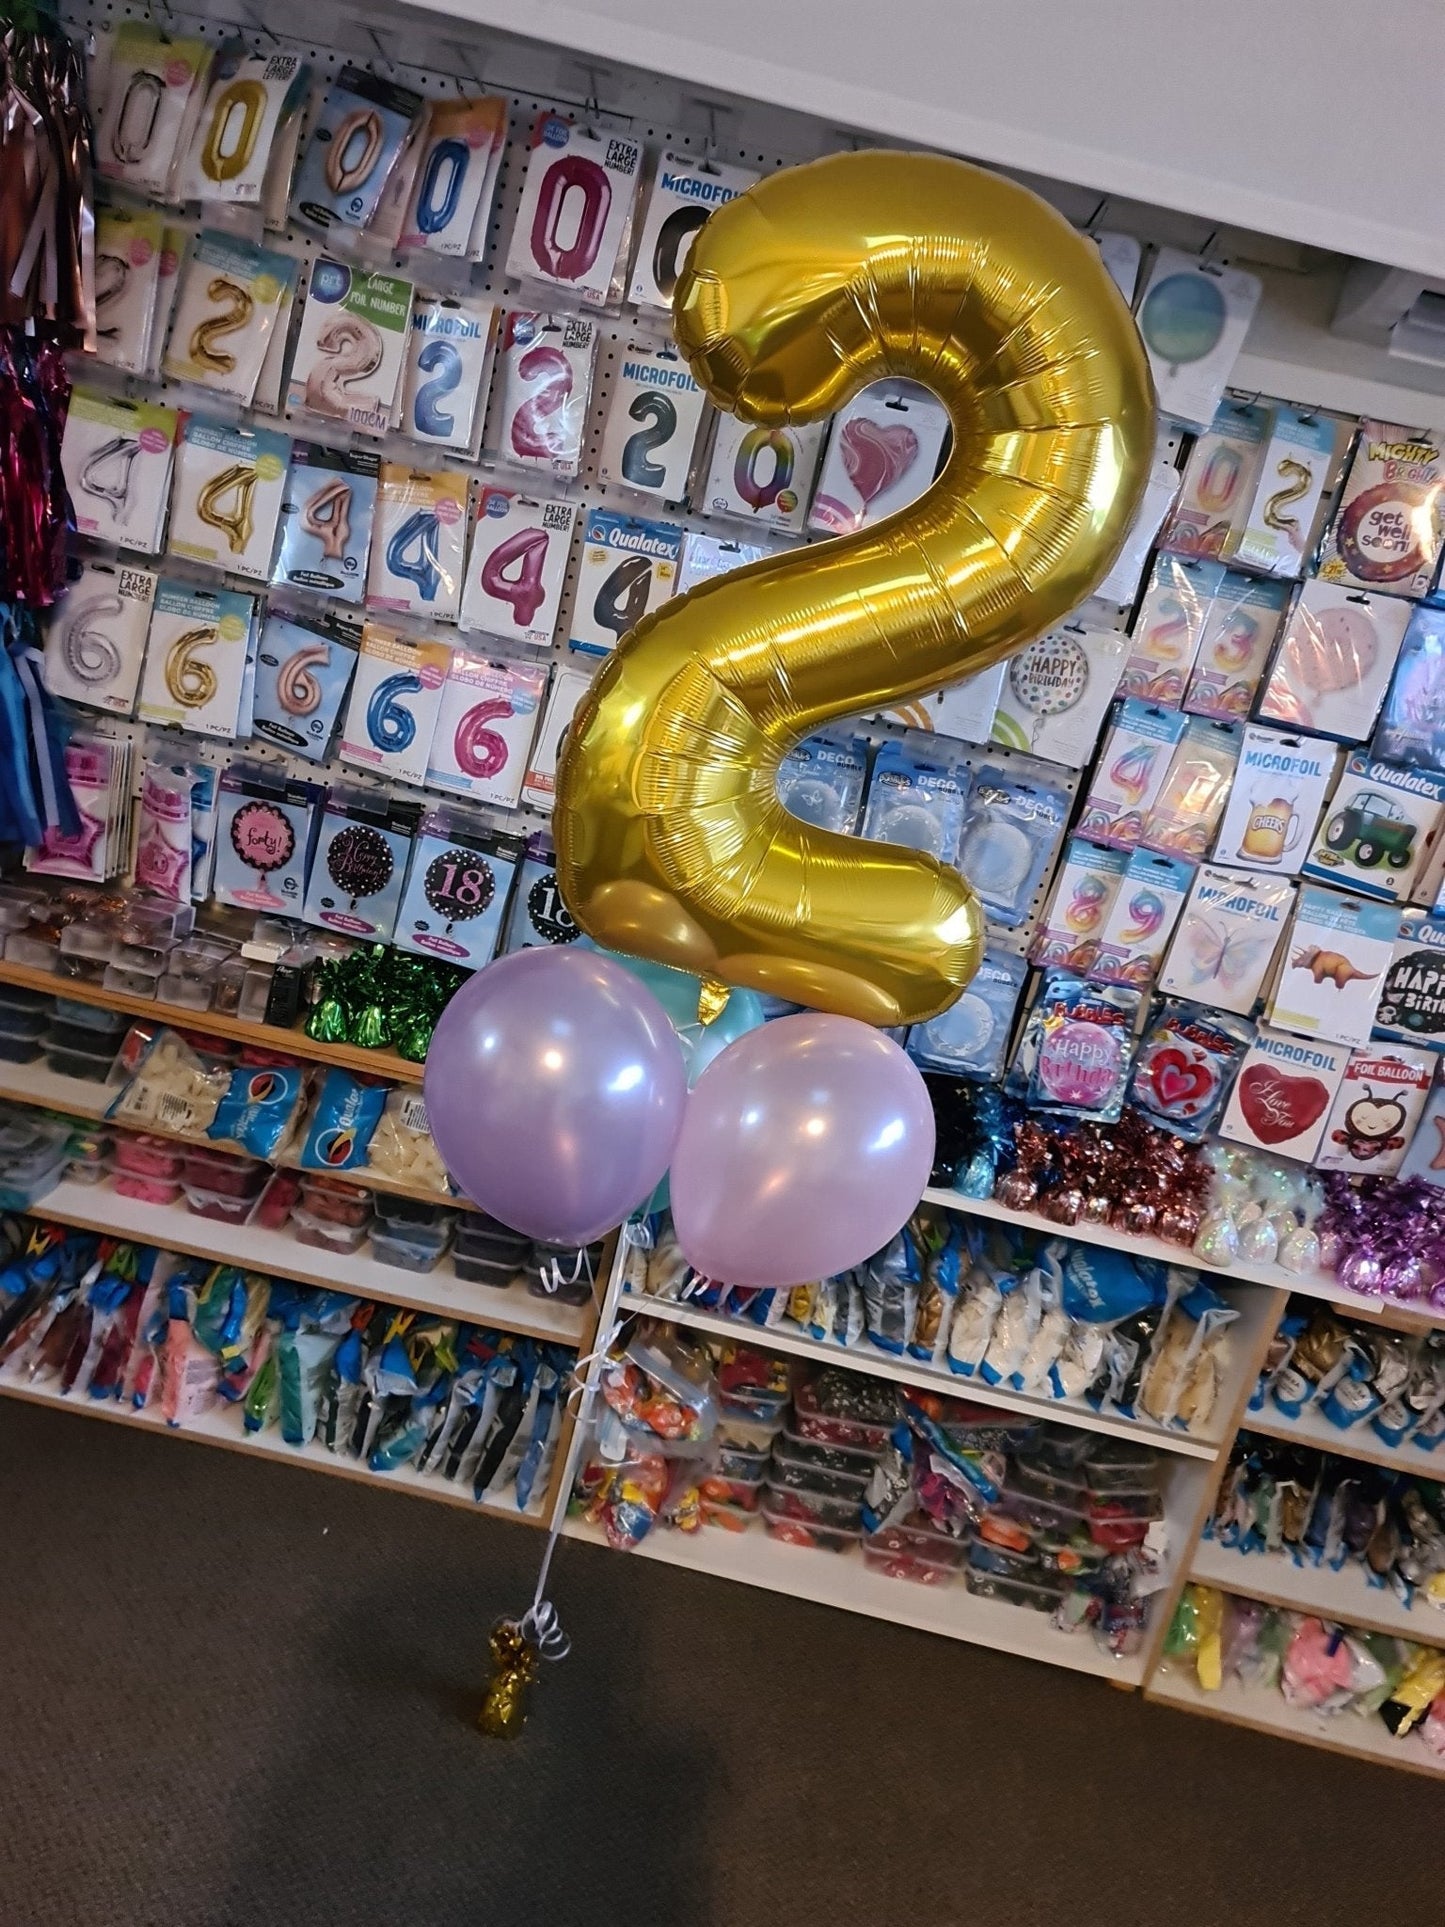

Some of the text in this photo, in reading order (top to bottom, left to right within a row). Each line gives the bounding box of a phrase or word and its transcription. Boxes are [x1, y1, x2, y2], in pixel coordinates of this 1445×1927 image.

[266, 64, 295, 75] LARGE
[271, 56, 298, 67] EXTRA
[609, 139, 638, 158] EXTRA
[604, 159, 635, 176] NUMBER!
[606, 149, 637, 169] LARGE
[661, 173, 747, 205] MICROFO
[368, 280, 395, 296] LARGE
[350, 290, 406, 317] FOIL NUMBER
[412, 313, 482, 339] MICROFOIL
[566, 320, 592, 333] EXTRA
[564, 331, 591, 343] LARGE
[623, 361, 700, 393] MICROFOIL
[350, 407, 387, 430] 100CM
[1368, 441, 1440, 467] MIGHTY
[543, 513, 571, 526] LARGE
[545, 503, 572, 516] EXTRA
[1369, 510, 1404, 526] get
[541, 522, 570, 533] NUMBER!
[1378, 525, 1410, 540] well
[609, 527, 677, 560] Qualatex
[119, 579, 151, 596] LARGE
[121, 570, 152, 587] EXTRA
[1031, 655, 1077, 677] HAPPY
[817, 750, 855, 765] DECO
[1244, 751, 1322, 777] MICROFOIL
[917, 775, 957, 789] DECO
[1370, 762, 1444, 800] Qualatex
[1015, 794, 1054, 815] DECO
[1252, 814, 1286, 834] CHEERS
[246, 827, 282, 855] forty!
[435, 864, 485, 905] 18
[537, 888, 576, 928] 18
[1055, 1039, 1113, 1066] Happy
[1254, 1038, 1337, 1072] MICROFOIL
[1355, 1062, 1424, 1082] FOIL BALLOON
[1257, 1089, 1293, 1113] Love
[1261, 1107, 1296, 1129] You
